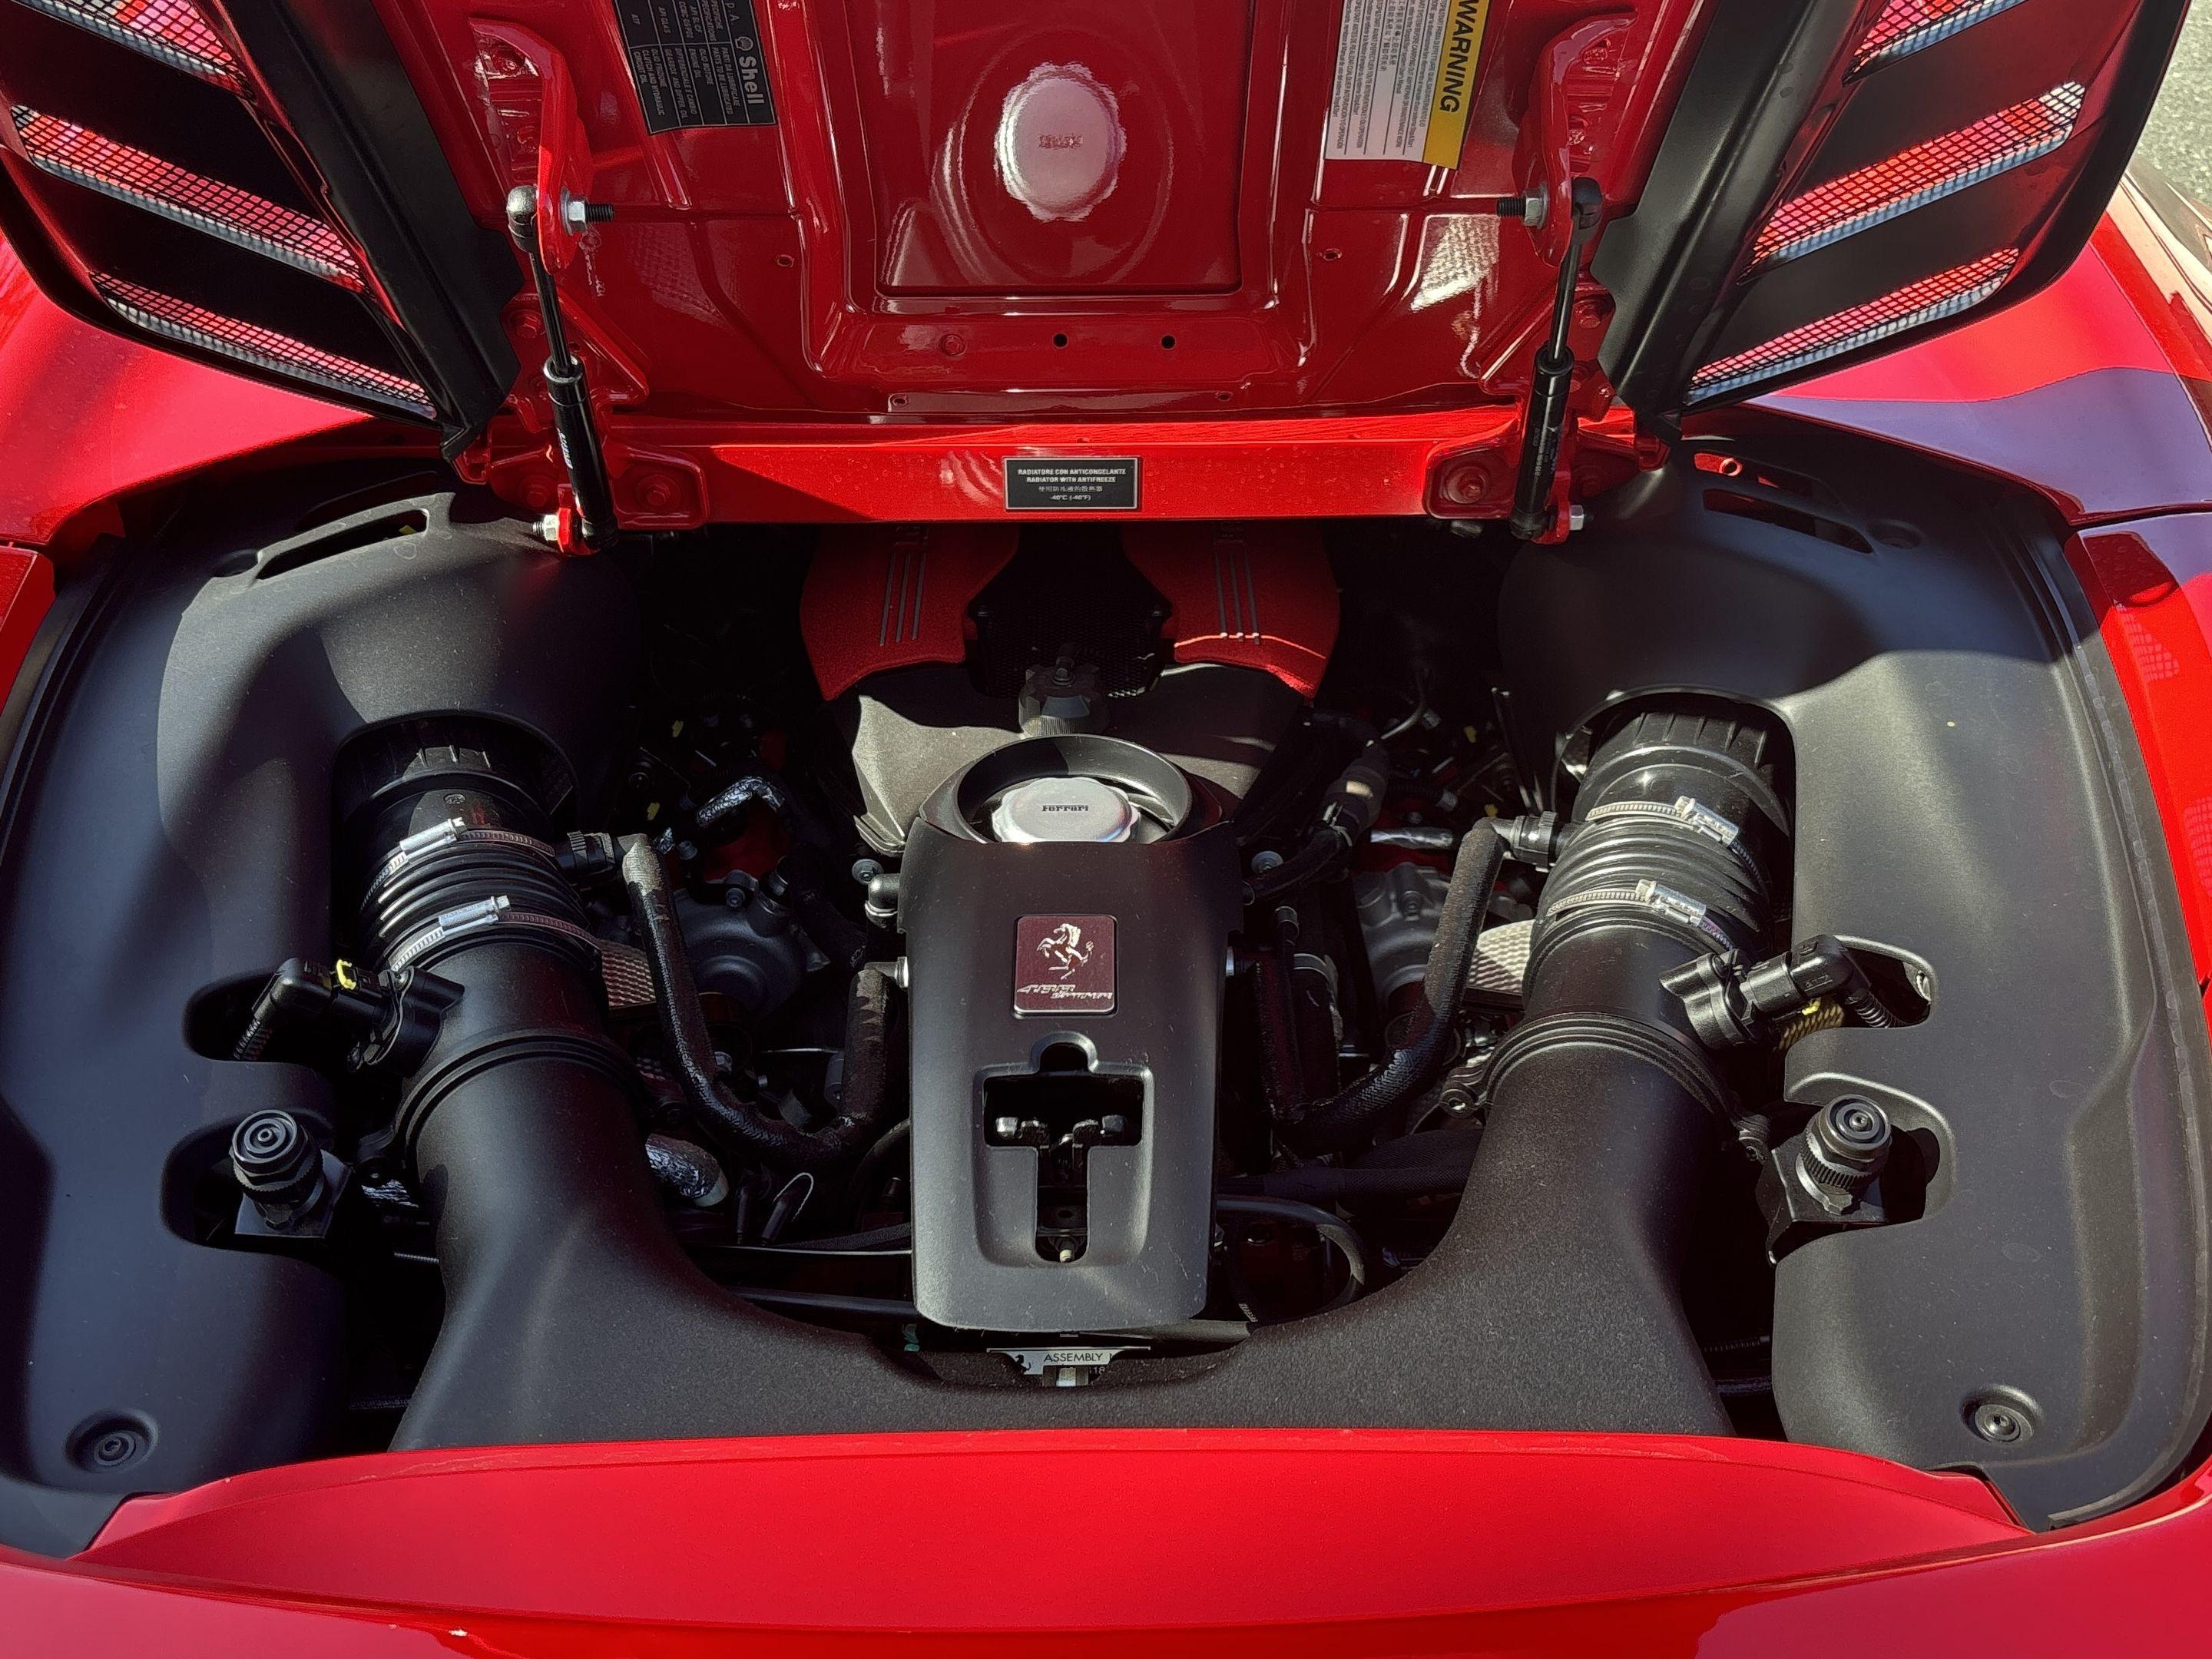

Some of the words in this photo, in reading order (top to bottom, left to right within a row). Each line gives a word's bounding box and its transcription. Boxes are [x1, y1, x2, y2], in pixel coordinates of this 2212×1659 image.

[739, 56, 765, 104] Shell
[1439, 0, 1480, 112] WARNING
[1044, 1353, 1103, 1363] ASSEMBLY
